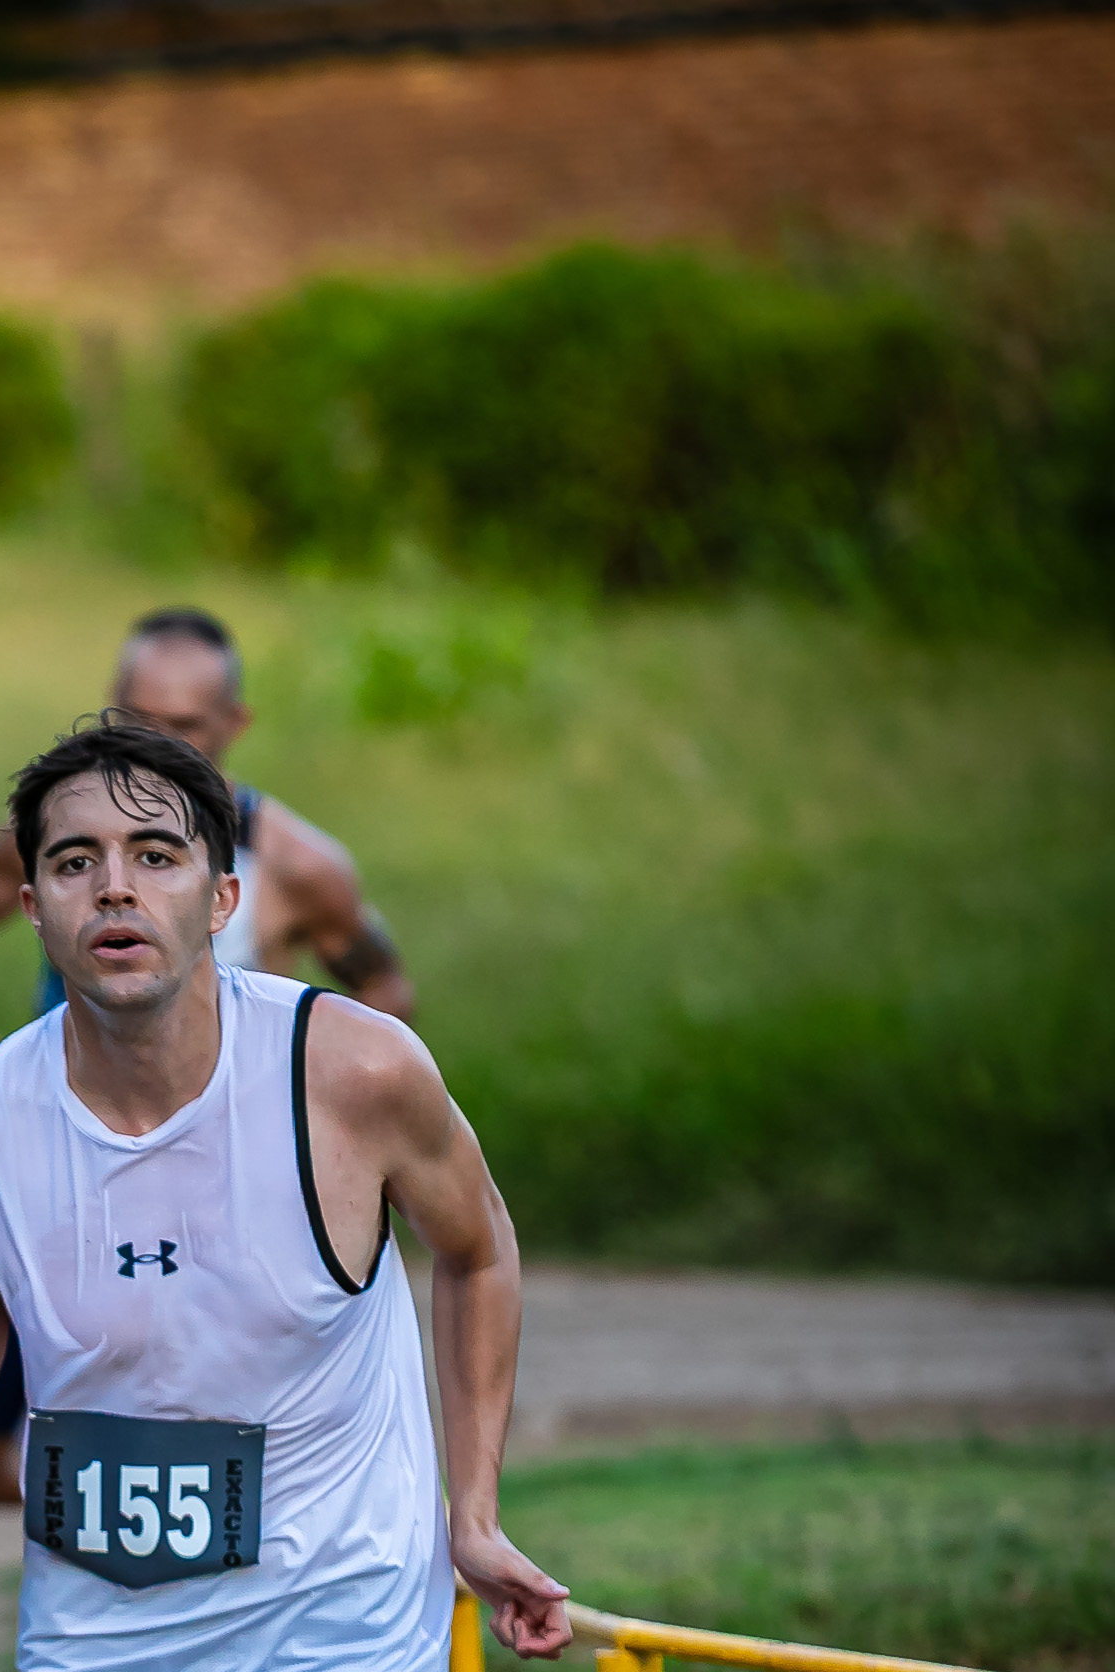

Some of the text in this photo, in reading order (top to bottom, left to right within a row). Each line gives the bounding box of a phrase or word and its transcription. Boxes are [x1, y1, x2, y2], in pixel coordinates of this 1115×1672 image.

[44, 1445, 65, 1549] TIEMPO
[77, 1460, 212, 1559] 155
[223, 1458, 244, 1567] EXACTO
